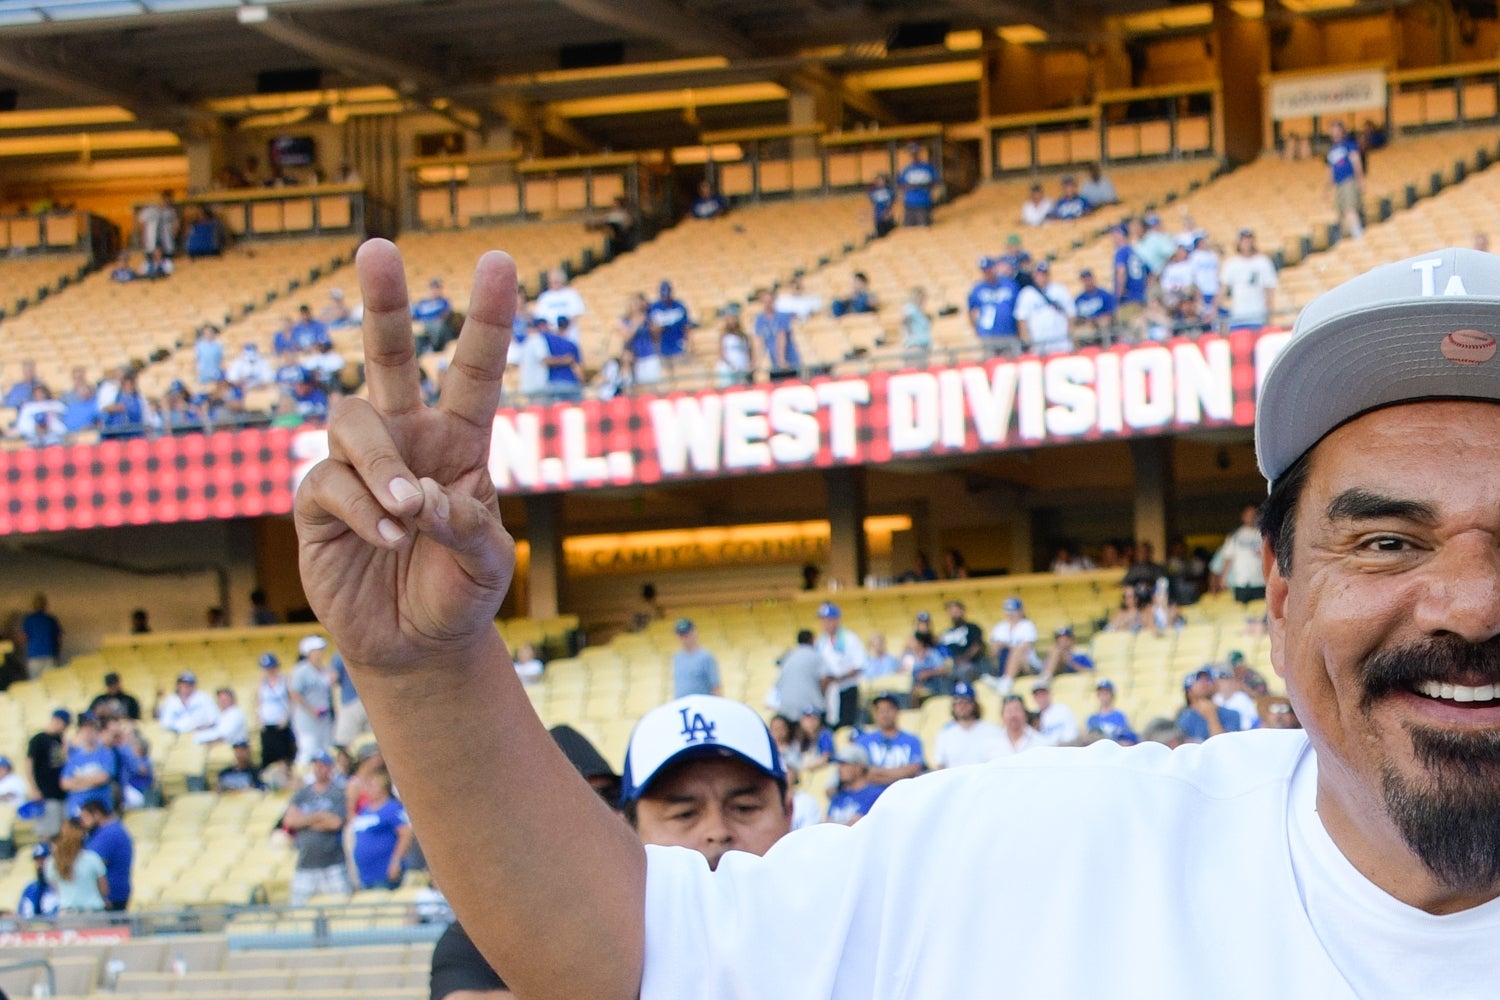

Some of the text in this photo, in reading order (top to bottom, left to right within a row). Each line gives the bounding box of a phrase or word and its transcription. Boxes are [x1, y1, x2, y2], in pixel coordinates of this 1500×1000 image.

[487, 407, 634, 488] N.L.
[651, 380, 870, 475] WEST
[886, 339, 1234, 453] DIVISION
[679, 707, 717, 743] LA
